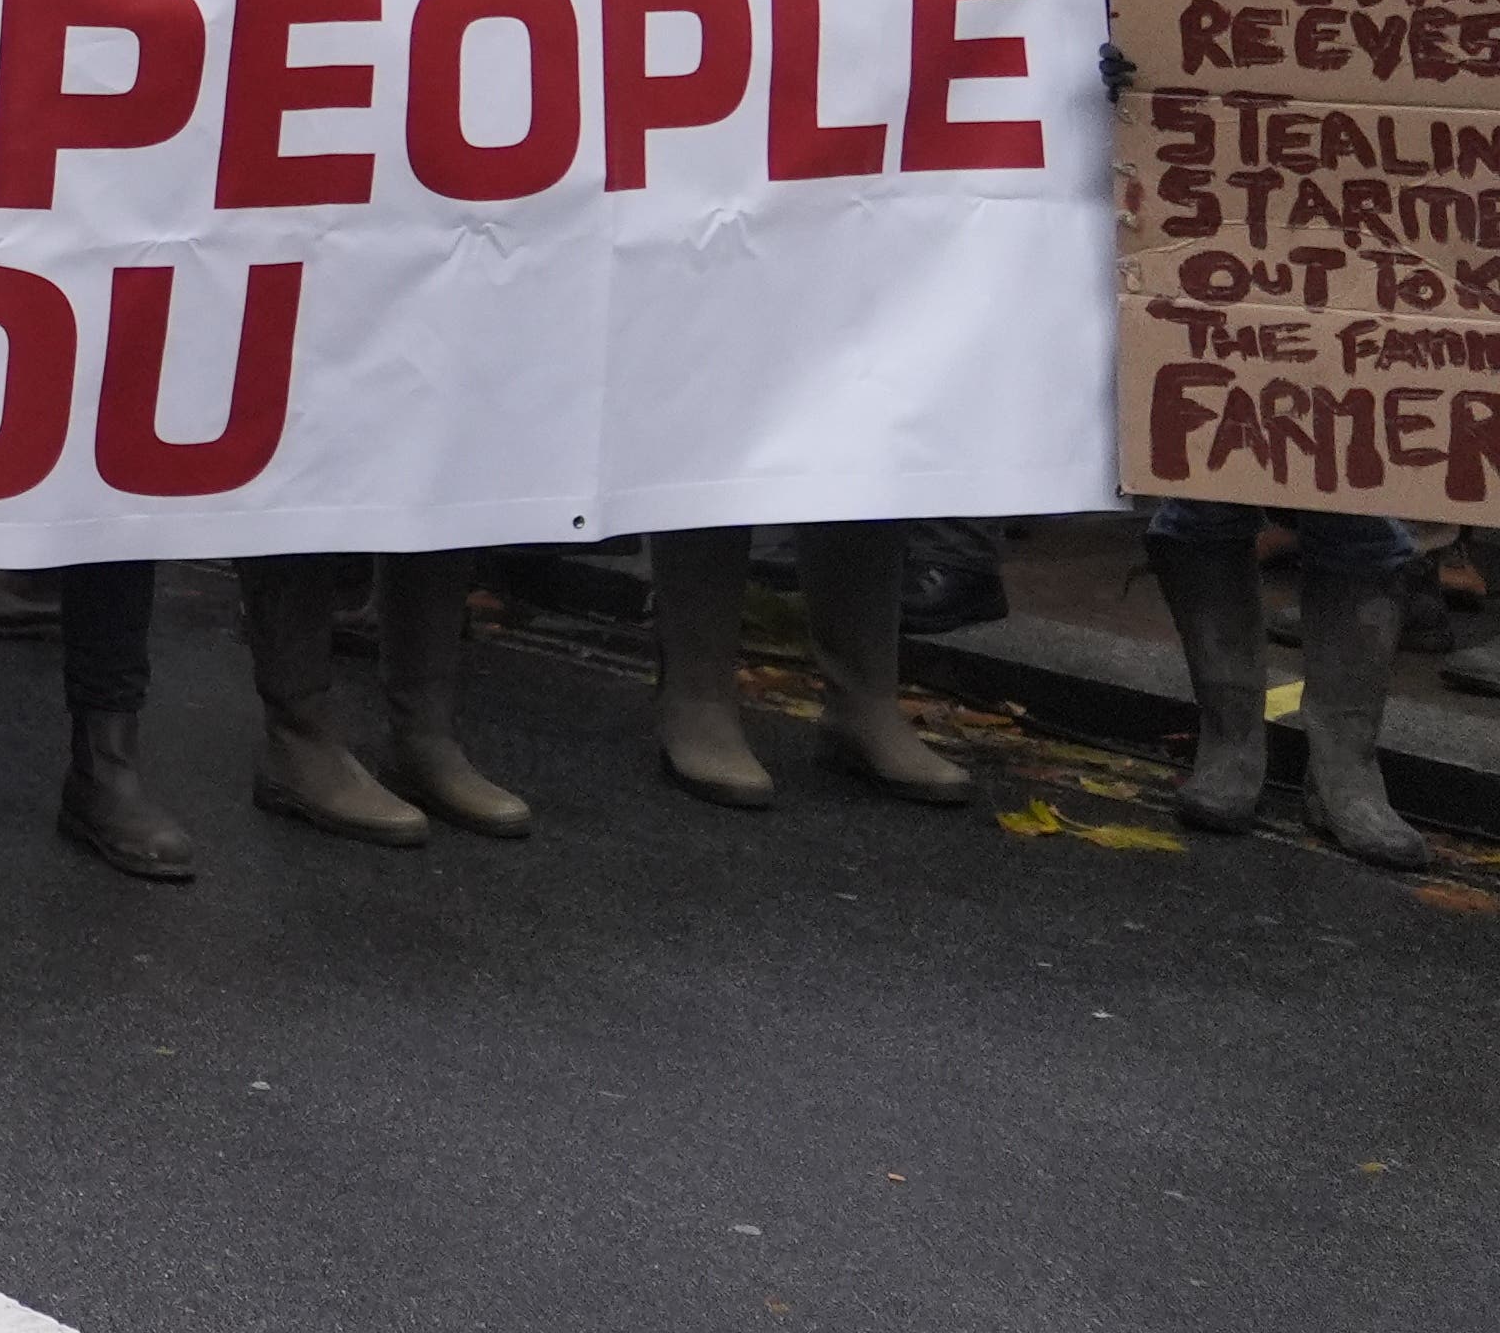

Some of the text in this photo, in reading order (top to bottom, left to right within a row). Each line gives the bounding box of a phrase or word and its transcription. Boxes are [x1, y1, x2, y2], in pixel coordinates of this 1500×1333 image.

[1151, 87, 1500, 179] STEALIN
[1157, 165, 1500, 250] STARME
[1178, 247, 1347, 313] OUT
[1455, 255, 1500, 314] K
[1146, 298, 1318, 363] THE
[1150, 361, 1500, 502] FARMER
